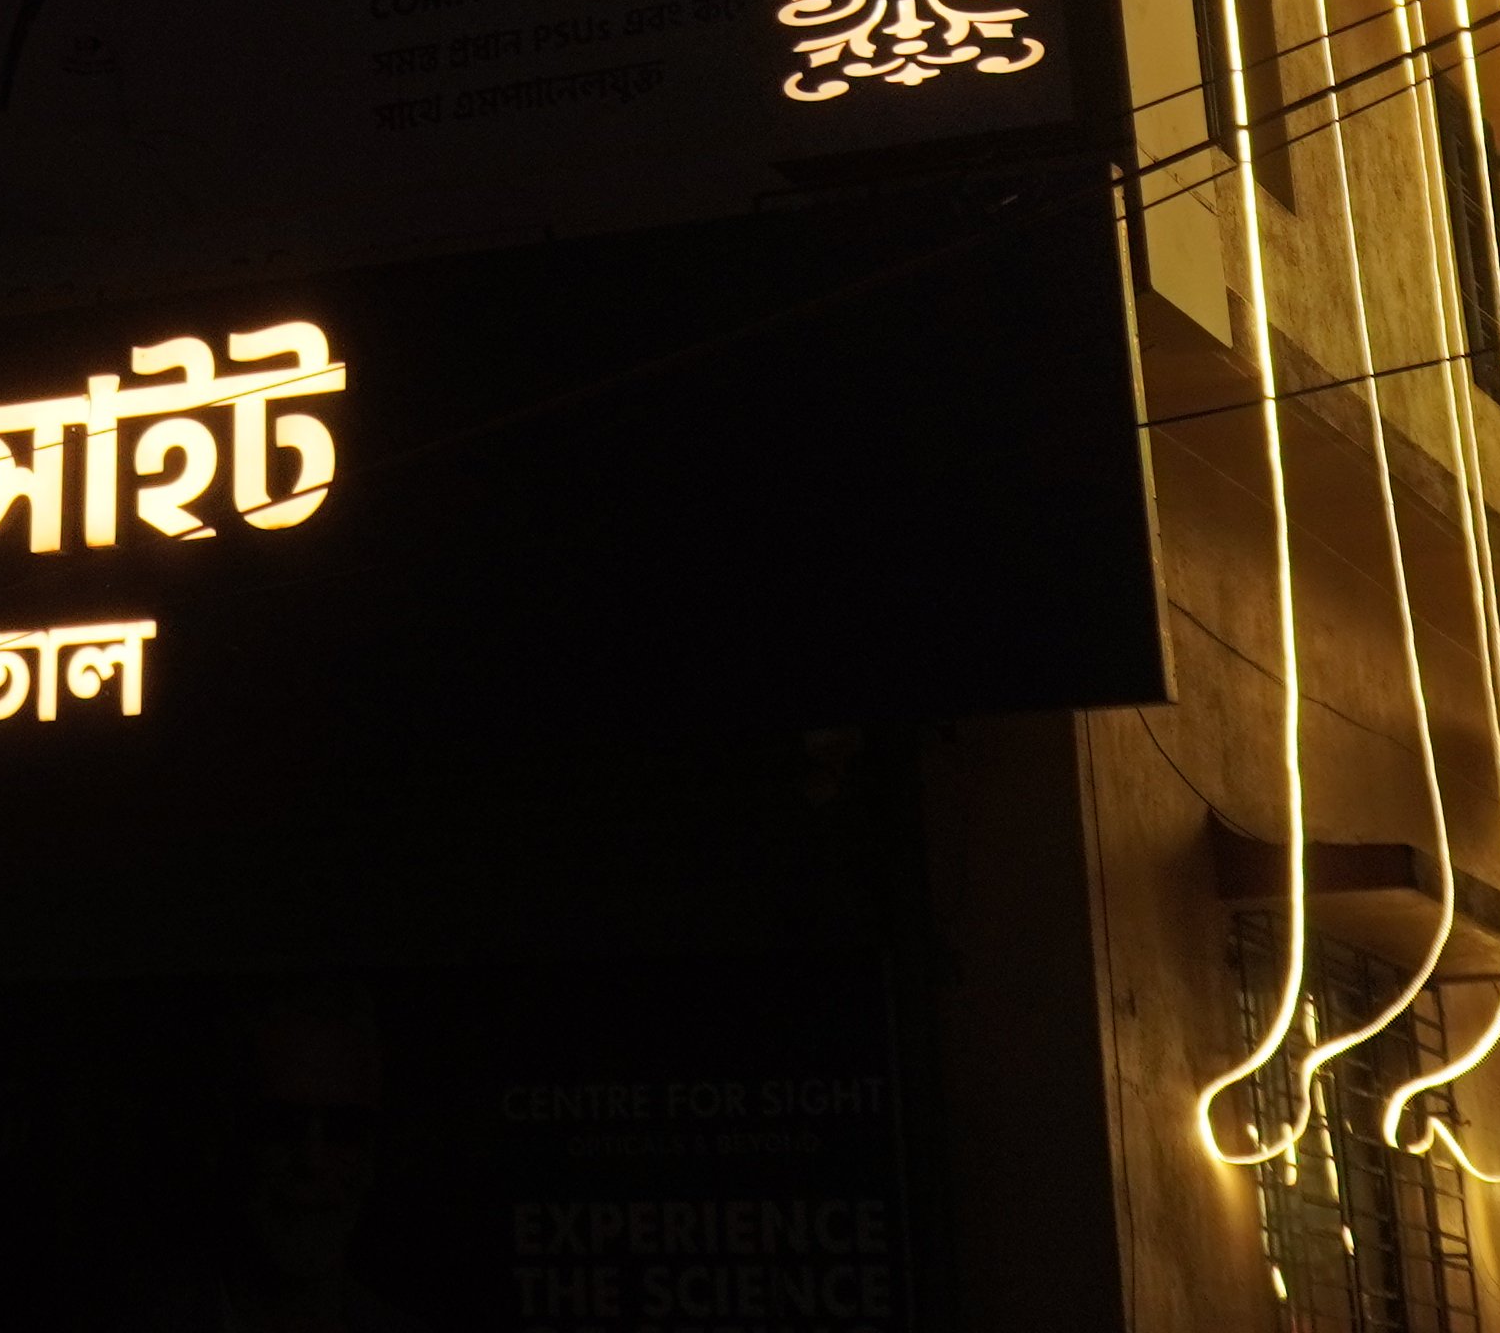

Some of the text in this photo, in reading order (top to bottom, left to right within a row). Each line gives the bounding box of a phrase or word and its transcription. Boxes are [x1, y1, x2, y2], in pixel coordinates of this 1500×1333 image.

[501, 1075, 886, 1122] CENTRE FOR SIGHT
[512, 1198, 890, 1257] EXPERIENCE
[512, 1262, 893, 1320] THE SCIENCE
